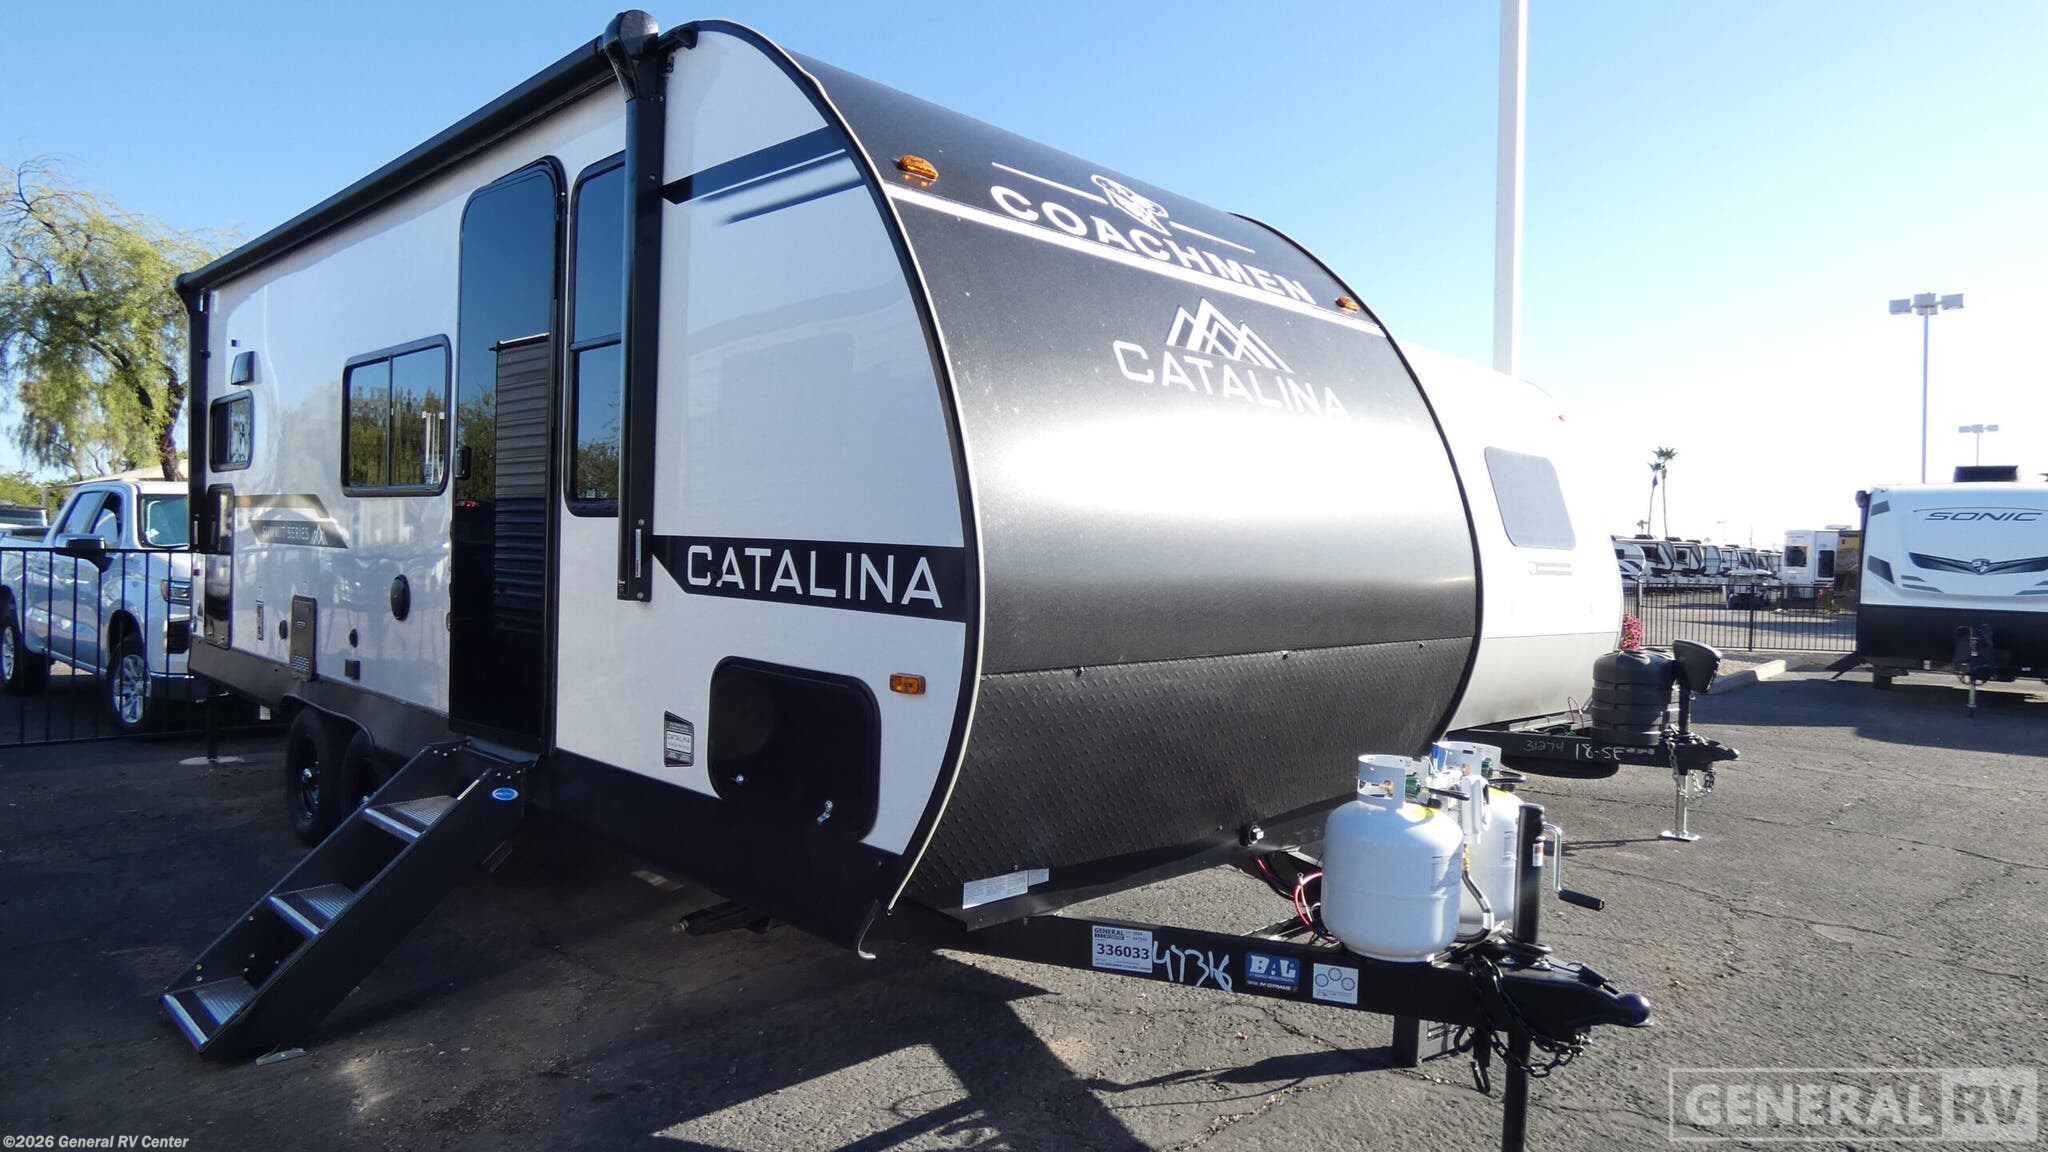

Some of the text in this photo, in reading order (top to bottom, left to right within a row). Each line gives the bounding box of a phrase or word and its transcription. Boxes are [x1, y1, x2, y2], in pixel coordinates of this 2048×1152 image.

[991, 185, 1316, 305] COACHMEN
[1113, 340, 1348, 420] CATALINA
[1925, 512, 2043, 521] SONIC
[287, 526, 309, 540] SERIES
[687, 545, 943, 608] CATALINA
[1094, 927, 1123, 936] GENERAL
[1096, 943, 1150, 960] 336033
